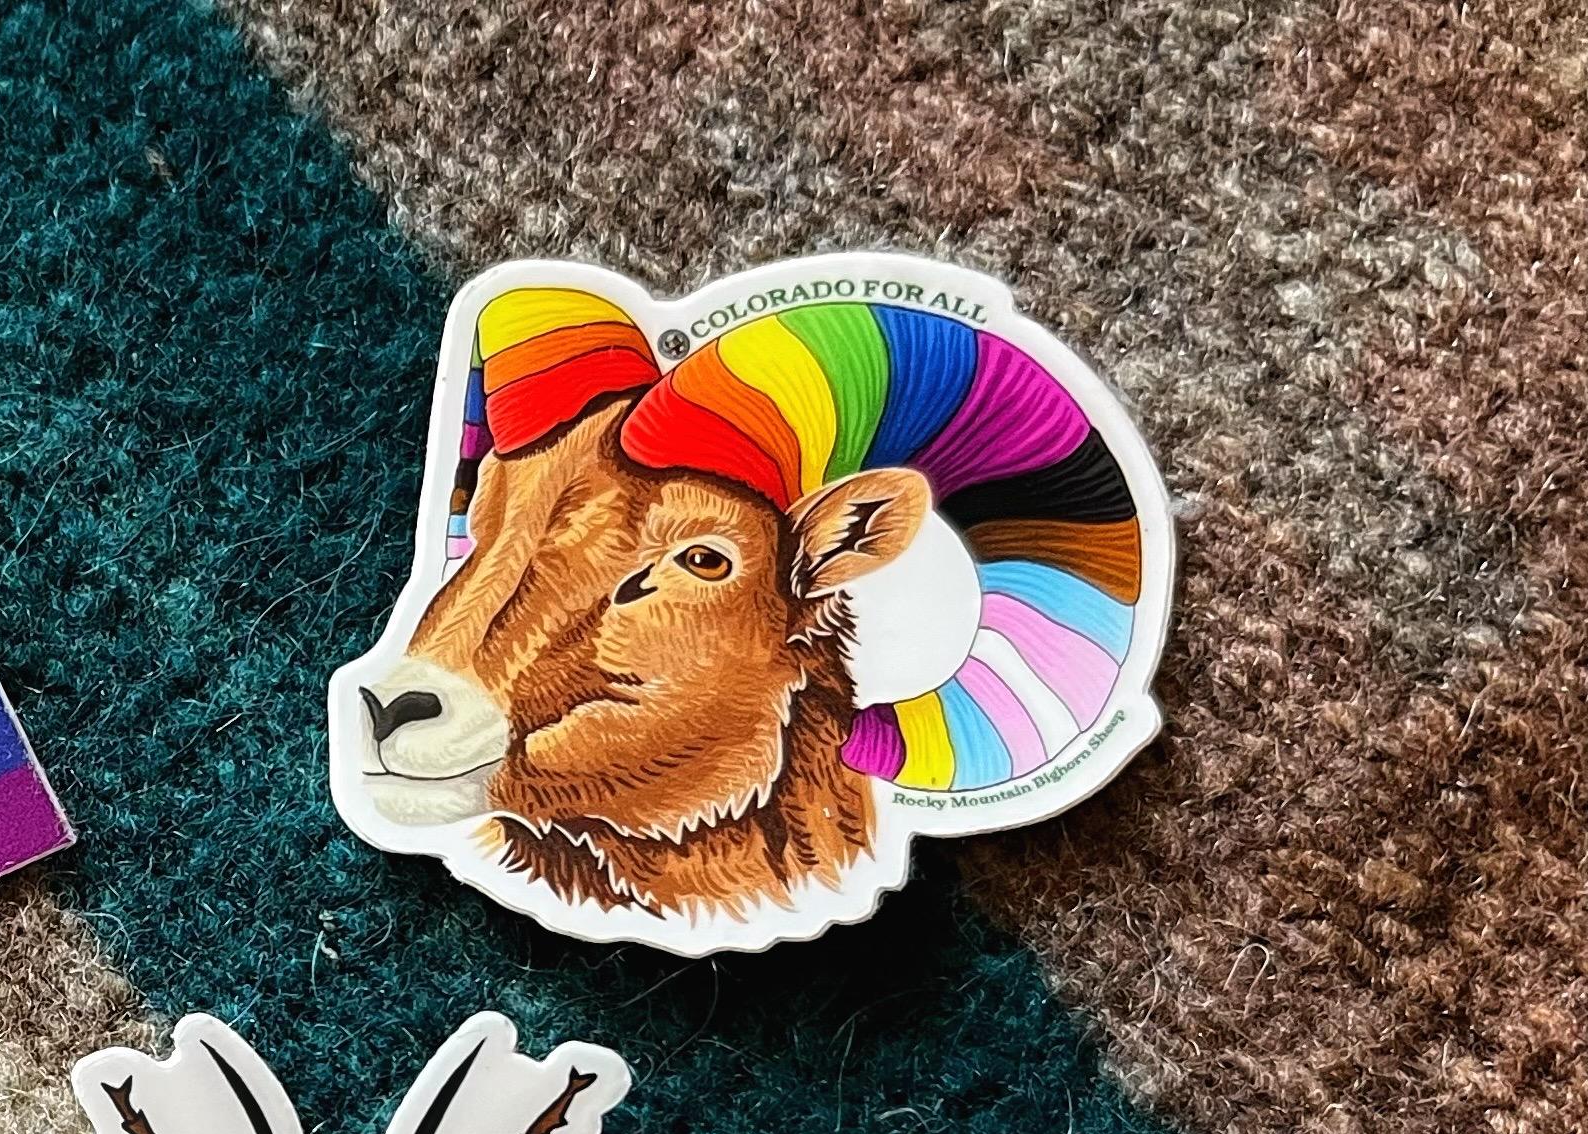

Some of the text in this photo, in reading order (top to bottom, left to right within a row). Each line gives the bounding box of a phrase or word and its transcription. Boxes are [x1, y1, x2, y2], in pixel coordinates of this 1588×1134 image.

[690, 278, 988, 339] COLORADO FOR ALL
[891, 709, 1127, 811] Rocky Mountain Bighorn Sheep
